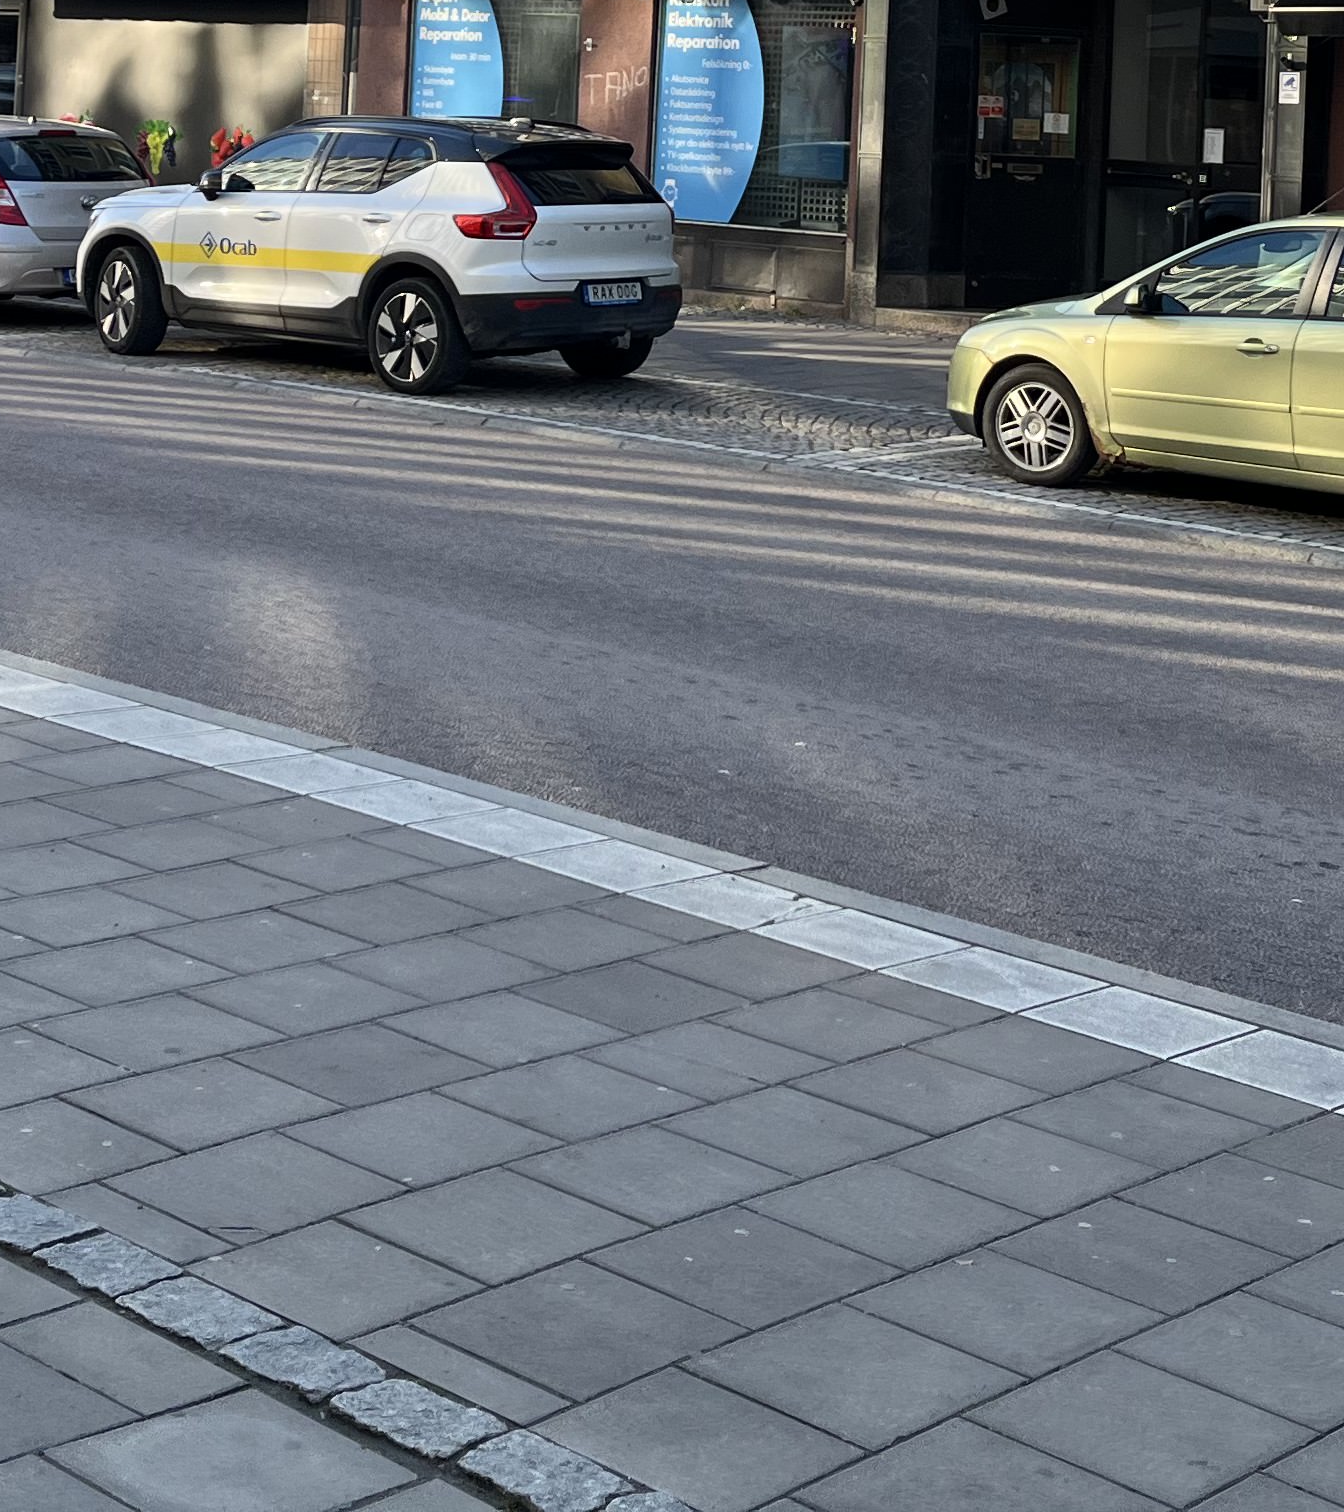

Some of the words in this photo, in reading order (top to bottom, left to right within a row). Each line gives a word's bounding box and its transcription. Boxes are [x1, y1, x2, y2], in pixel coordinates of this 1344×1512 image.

[420, 7, 449, 22] Mobil
[450, 7, 459, 22] &
[460, 8, 491, 23] Dator
[668, 10, 734, 29] Elektronik
[419, 26, 483, 45] Reparation
[666, 32, 741, 53] Reparation
[219, 237, 258, 256] Ocab
[592, 285, 614, 300] RAX
